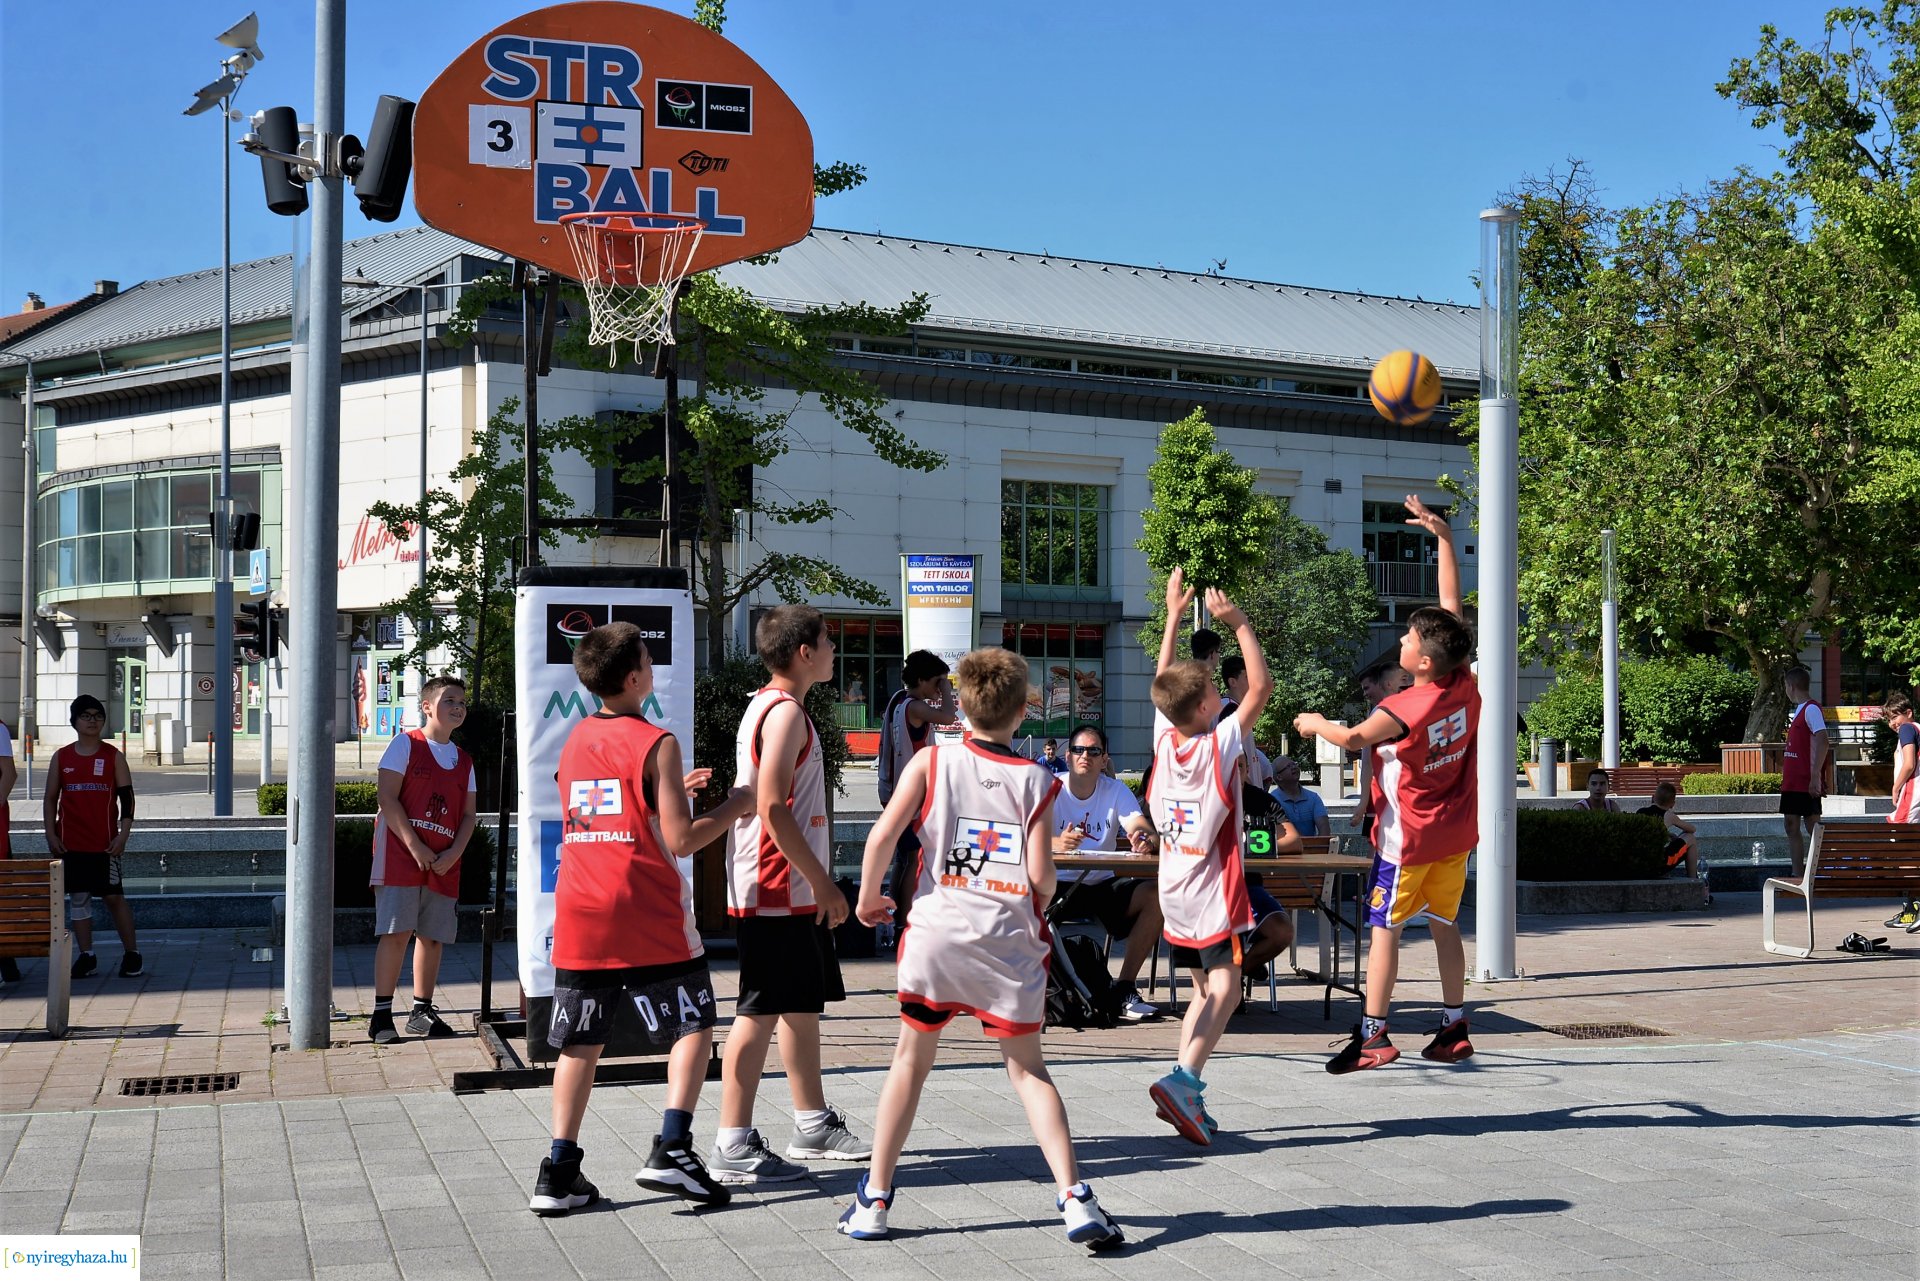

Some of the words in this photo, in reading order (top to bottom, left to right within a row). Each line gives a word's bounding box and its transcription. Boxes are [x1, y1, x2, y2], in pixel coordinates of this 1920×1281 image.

[481, 34, 643, 108] STR
[710, 104, 746, 113] MKOSZ
[487, 119, 514, 152] 3
[534, 159, 746, 236] BALL
[923, 570, 940, 579] TETT
[942, 570, 970, 579] ISKOLA
[911, 585, 935, 593] TOM
[936, 585, 969, 593] TAILOR
[640, 630, 666, 639] OSZ
[1081, 713, 1100, 721] coop
[1250, 830, 1271, 853] 3
